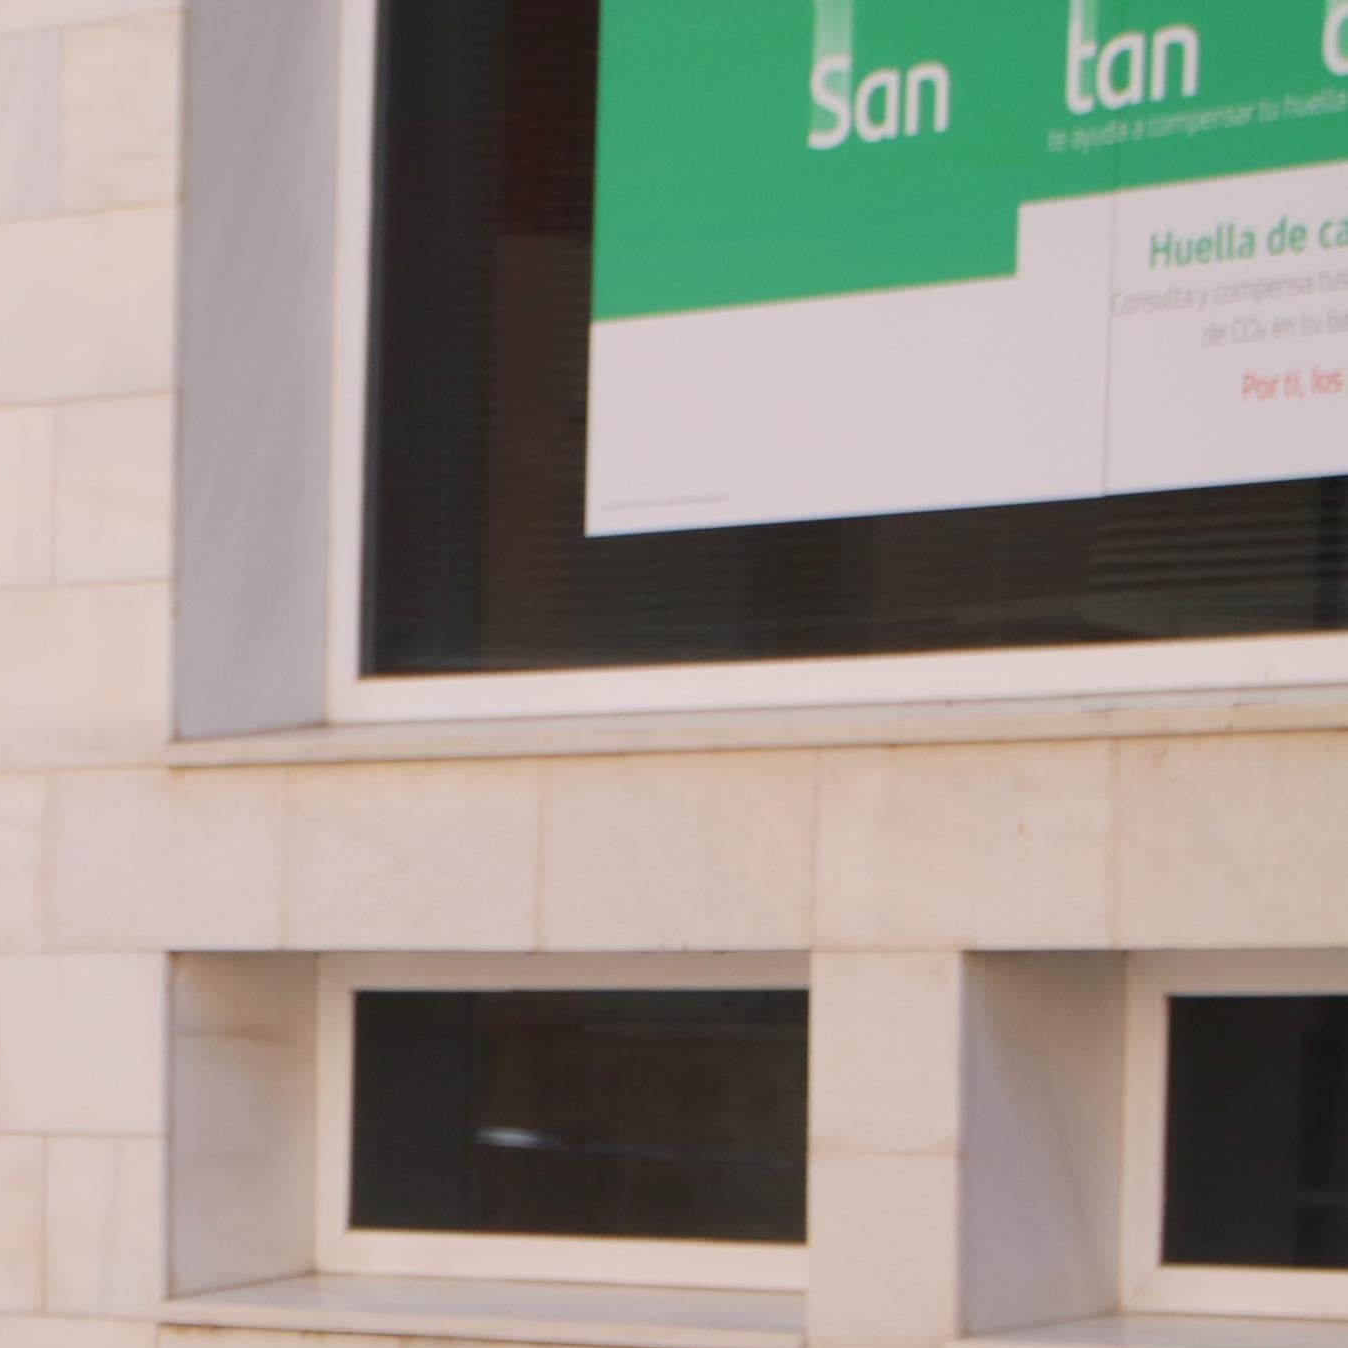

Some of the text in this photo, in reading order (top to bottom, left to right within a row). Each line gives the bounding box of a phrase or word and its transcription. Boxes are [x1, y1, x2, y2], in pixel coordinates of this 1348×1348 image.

[807, 54, 950, 150] San
[1065, 5, 1200, 115] tan
[1149, 222, 1256, 270] Huella
[1267, 214, 1309, 256] de
[1241, 367, 1278, 401] Por
[1310, 365, 1343, 394] los
